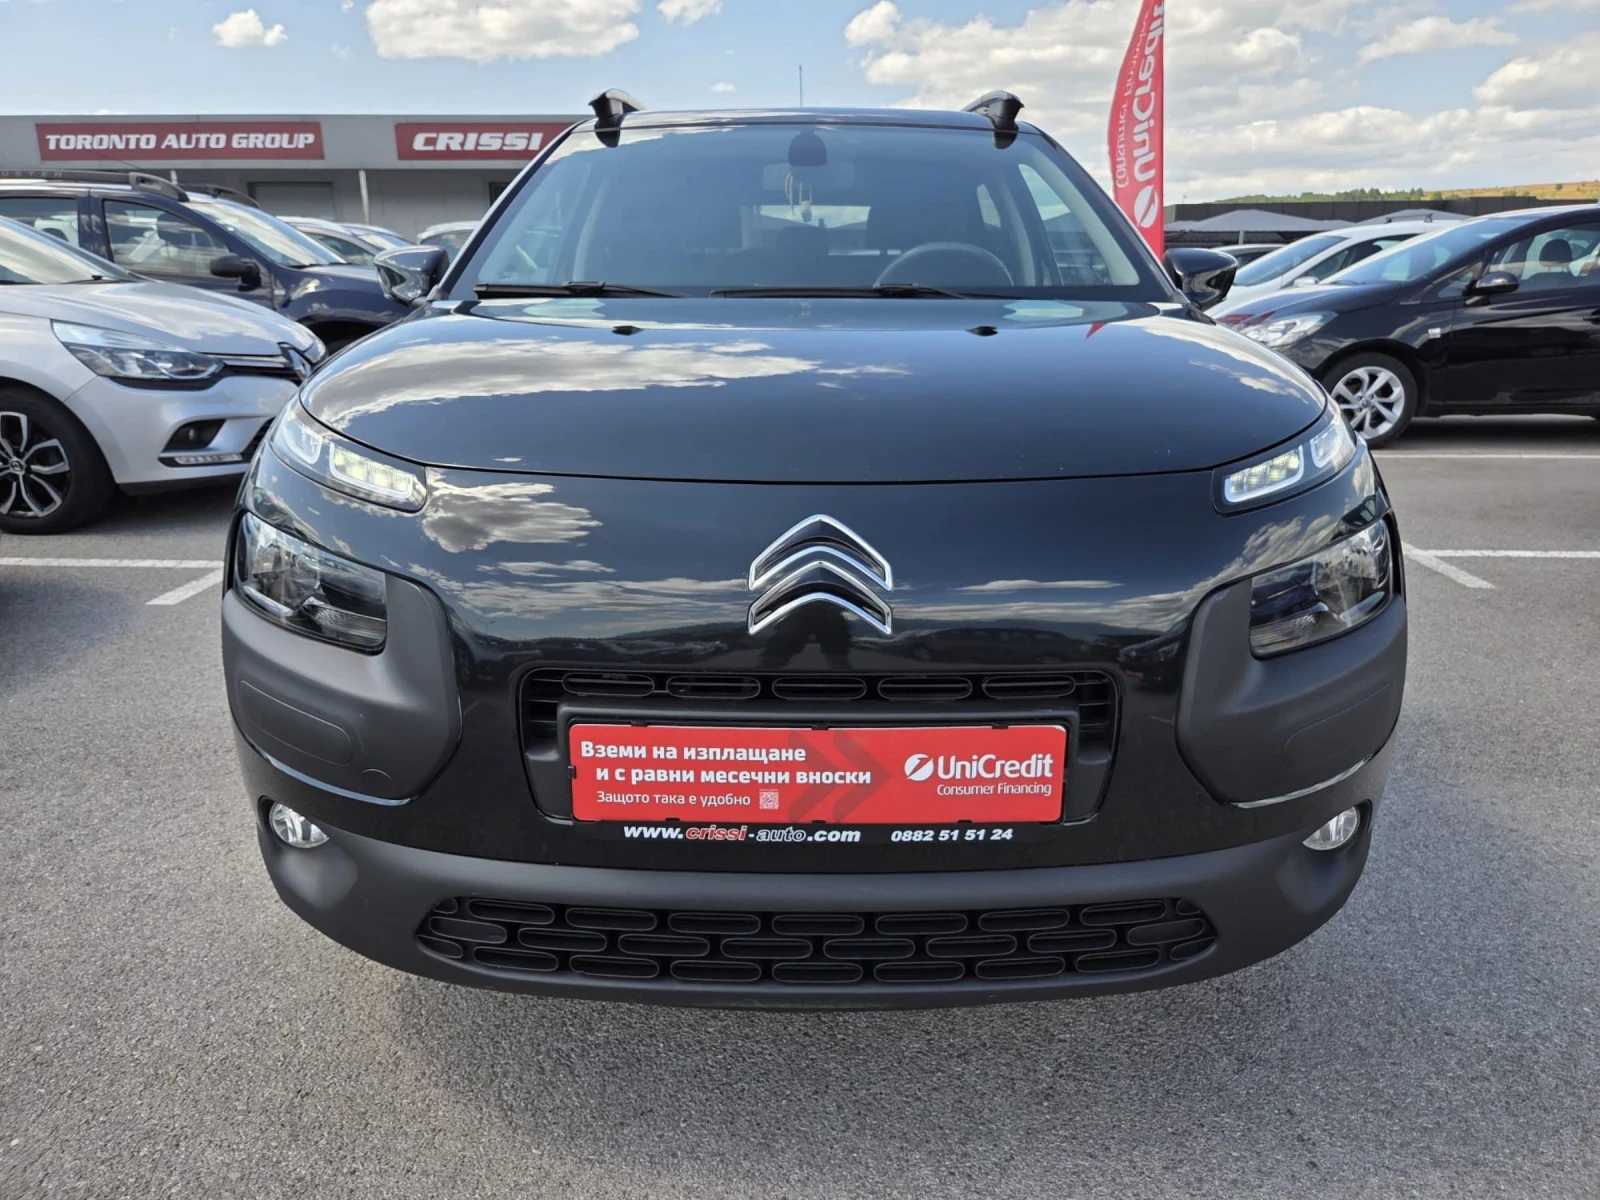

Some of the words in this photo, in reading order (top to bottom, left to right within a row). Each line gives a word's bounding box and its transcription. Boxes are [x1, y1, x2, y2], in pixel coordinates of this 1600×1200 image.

[45, 134, 157, 150] TORONTO
[160, 133, 227, 149] AUTO
[231, 133, 315, 149] GROUP
[412, 132, 544, 151] CRISSI
[580, 741, 647, 759] Вземи
[652, 745, 678, 760] на
[683, 746, 807, 764] изплащане
[936, 753, 1053, 780] UniCredit
[595, 767, 609, 781] и
[614, 768, 626, 781] с
[630, 769, 695, 785] равни
[700, 770, 790, 784] месечни
[795, 771, 872, 785] вноски
[936, 783, 995, 796] Consumer
[997, 782, 1052, 797] Financing
[596, 790, 650, 806] Защото
[652, 794, 686, 805] така
[688, 795, 697, 805] е
[700, 791, 751, 808] удобно
[623, 824, 862, 843] www.crissi-auto.com
[890, 829, 935, 842] 0882
[937, 829, 960, 842] 51
[963, 829, 986, 841] 51
[989, 828, 1014, 841] 24
